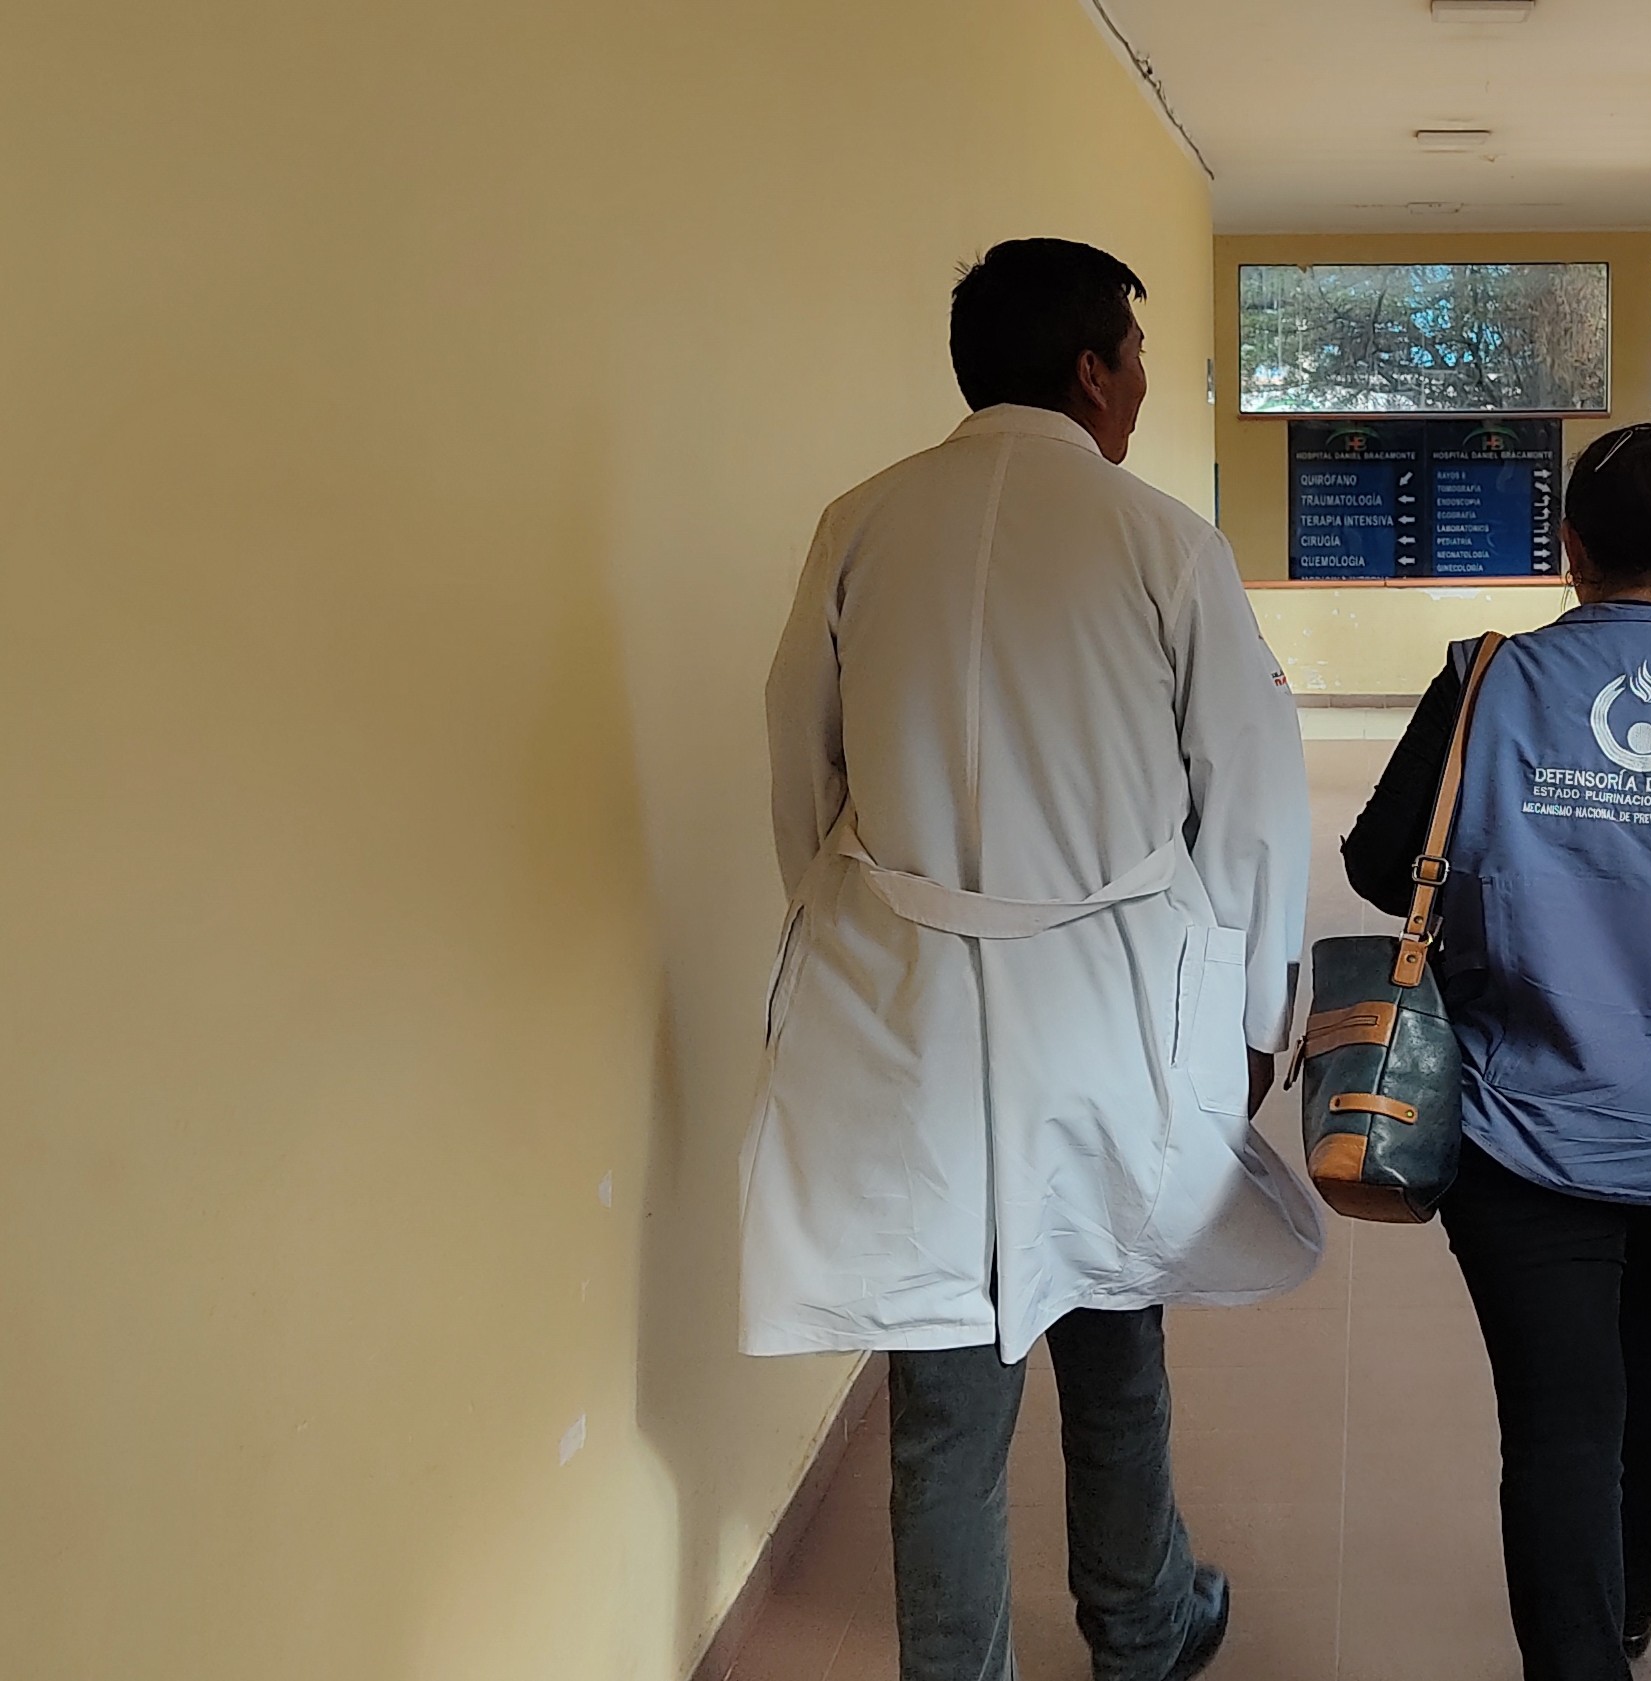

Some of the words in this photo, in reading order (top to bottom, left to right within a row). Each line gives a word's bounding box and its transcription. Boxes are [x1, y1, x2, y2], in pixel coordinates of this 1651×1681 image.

[1296, 451, 1333, 460] HOSPITAL
[1334, 451, 1362, 460] DANIEL
[1364, 451, 1416, 460] BRACAMONTE
[1433, 451, 1470, 459] HOSPITAL
[1471, 451, 1499, 459] DANIEL
[1300, 472, 1358, 486] QUIRÓFANO
[1436, 471, 1460, 480] RAYOS
[1300, 492, 1383, 506] TRAUMATOLOGÍA
[1300, 515, 1343, 527] TERAPIA
[1344, 515, 1394, 527] INTENSIVA
[1300, 534, 1342, 547] CIRUGÍA
[1534, 768, 1638, 792] DEFENSORÍA
[1533, 785, 1580, 800] ESTADO
[1522, 801, 1573, 817] MECANISMO
[1575, 806, 1617, 821] NACIONAL
[1619, 811, 1630, 822] DE
